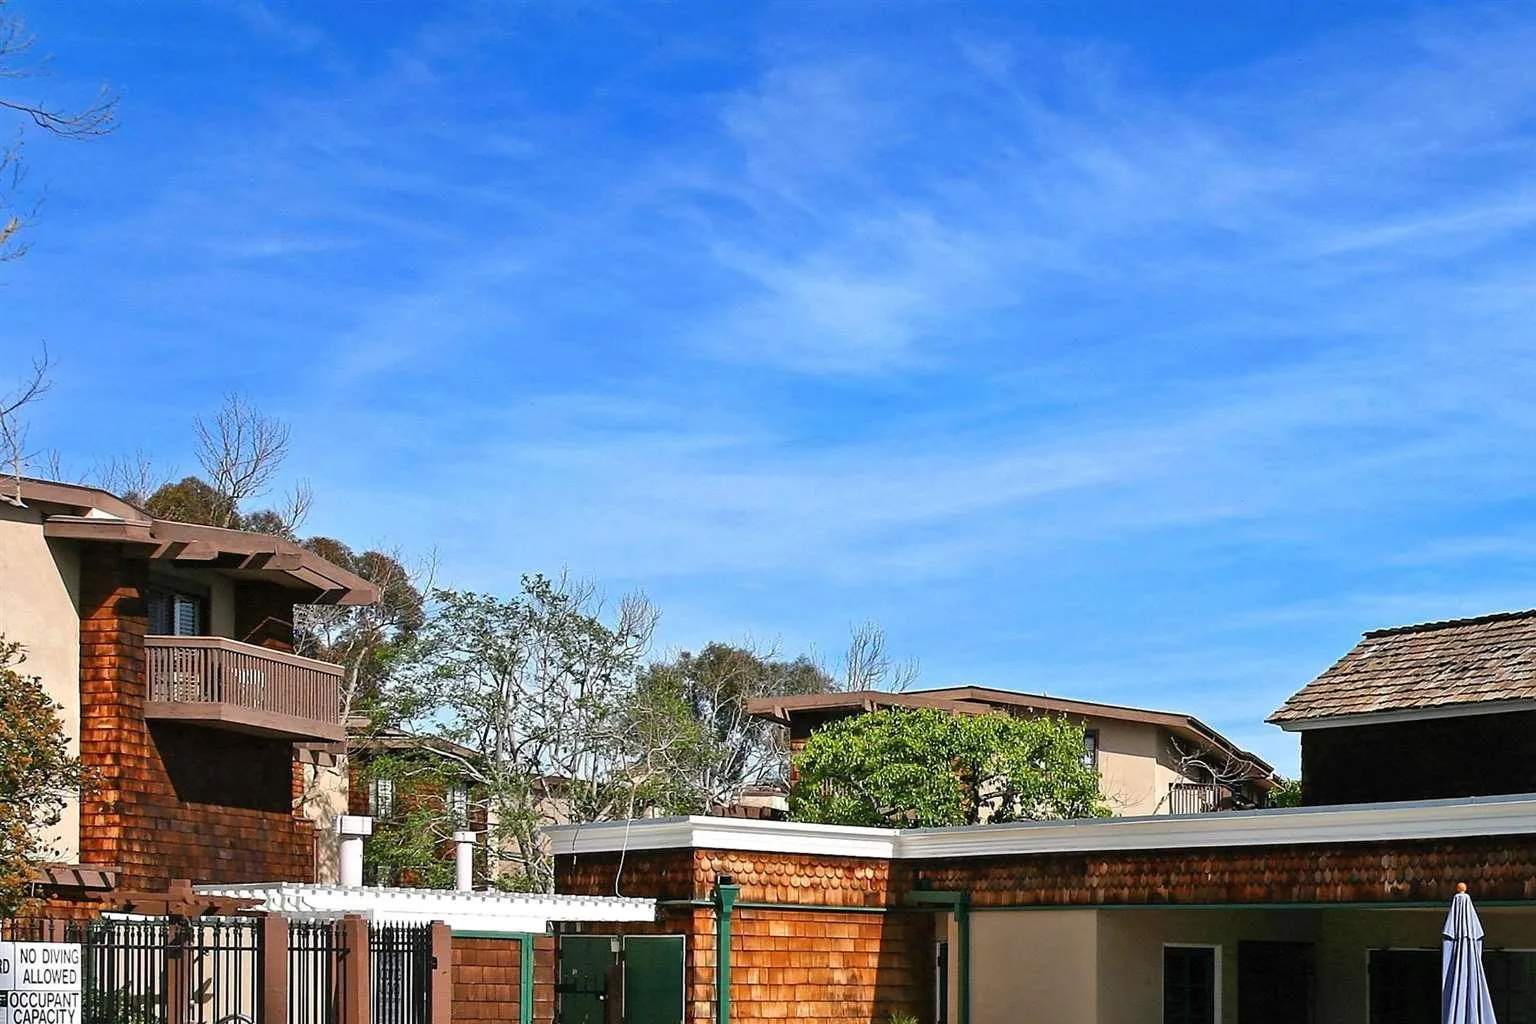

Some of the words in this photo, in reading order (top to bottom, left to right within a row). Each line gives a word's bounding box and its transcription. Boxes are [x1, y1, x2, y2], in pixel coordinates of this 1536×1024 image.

[20, 948, 37, 964] NO
[42, 948, 79, 964] DIVING
[23, 968, 77, 984] ALLOWED
[9, 992, 79, 1008] OCCUPANT
[13, 1008, 75, 1024] CAPACITY
